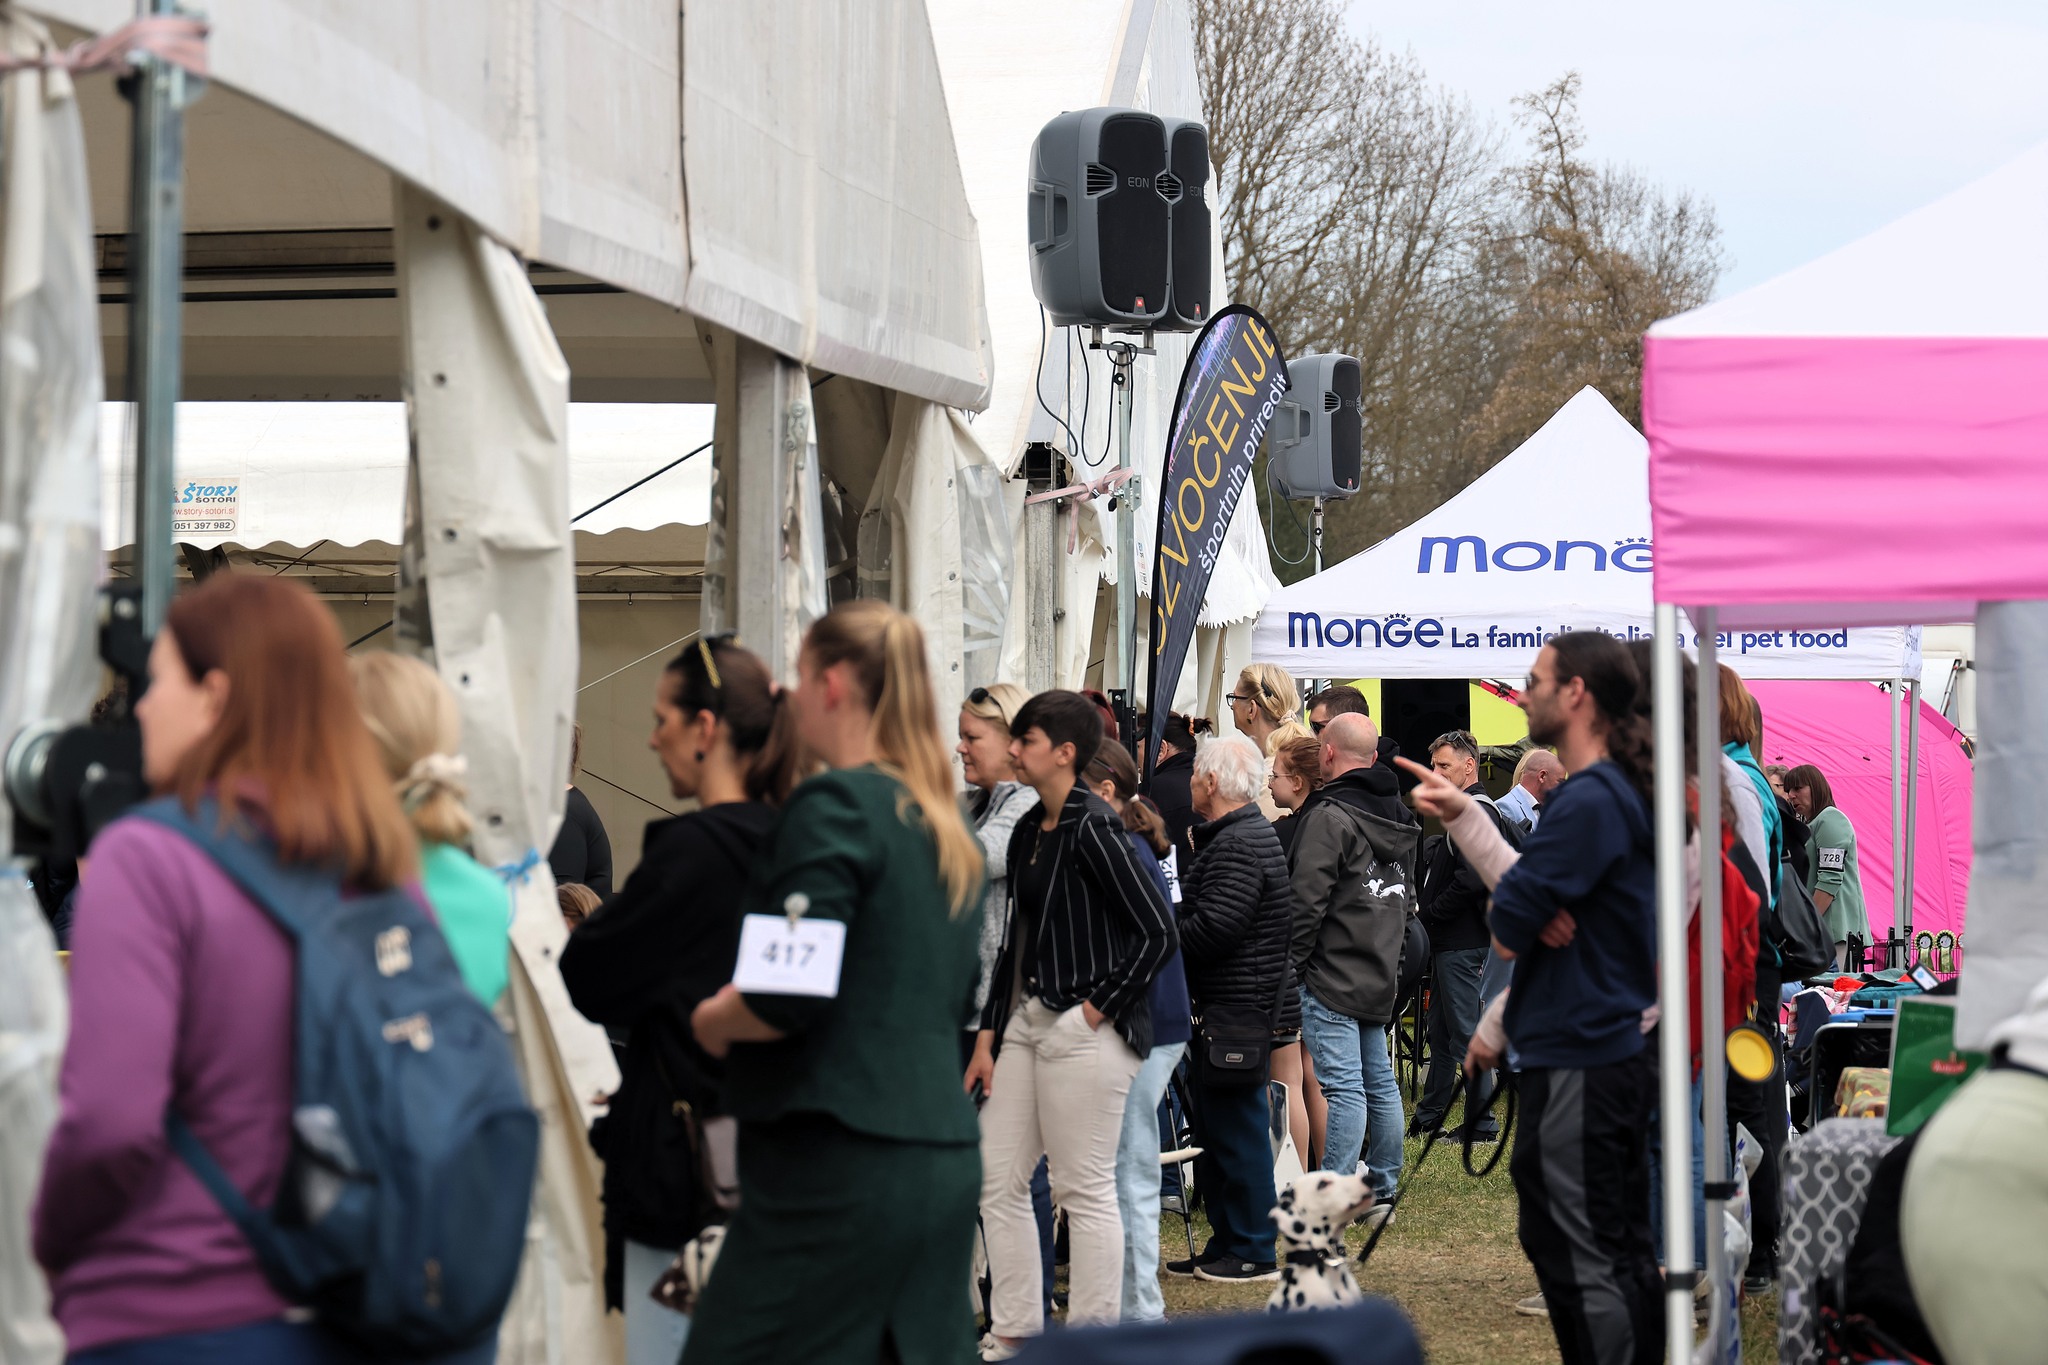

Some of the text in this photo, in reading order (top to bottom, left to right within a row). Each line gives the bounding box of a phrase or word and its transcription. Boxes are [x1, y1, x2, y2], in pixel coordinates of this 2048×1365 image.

[1127, 176, 1150, 188] EON
[181, 482, 238, 504] ŠTORY
[172, 506, 235, 517] w.story-sotori.si
[1199, 462, 1247, 575] športnih
[174, 521, 231, 530] 051 397 982
[1451, 626, 1480, 648] La
[1741, 630, 1783, 655] pet
[1789, 627, 1848, 648] food
[1823, 853, 1841, 863] 728
[760, 940, 817, 968] 417
